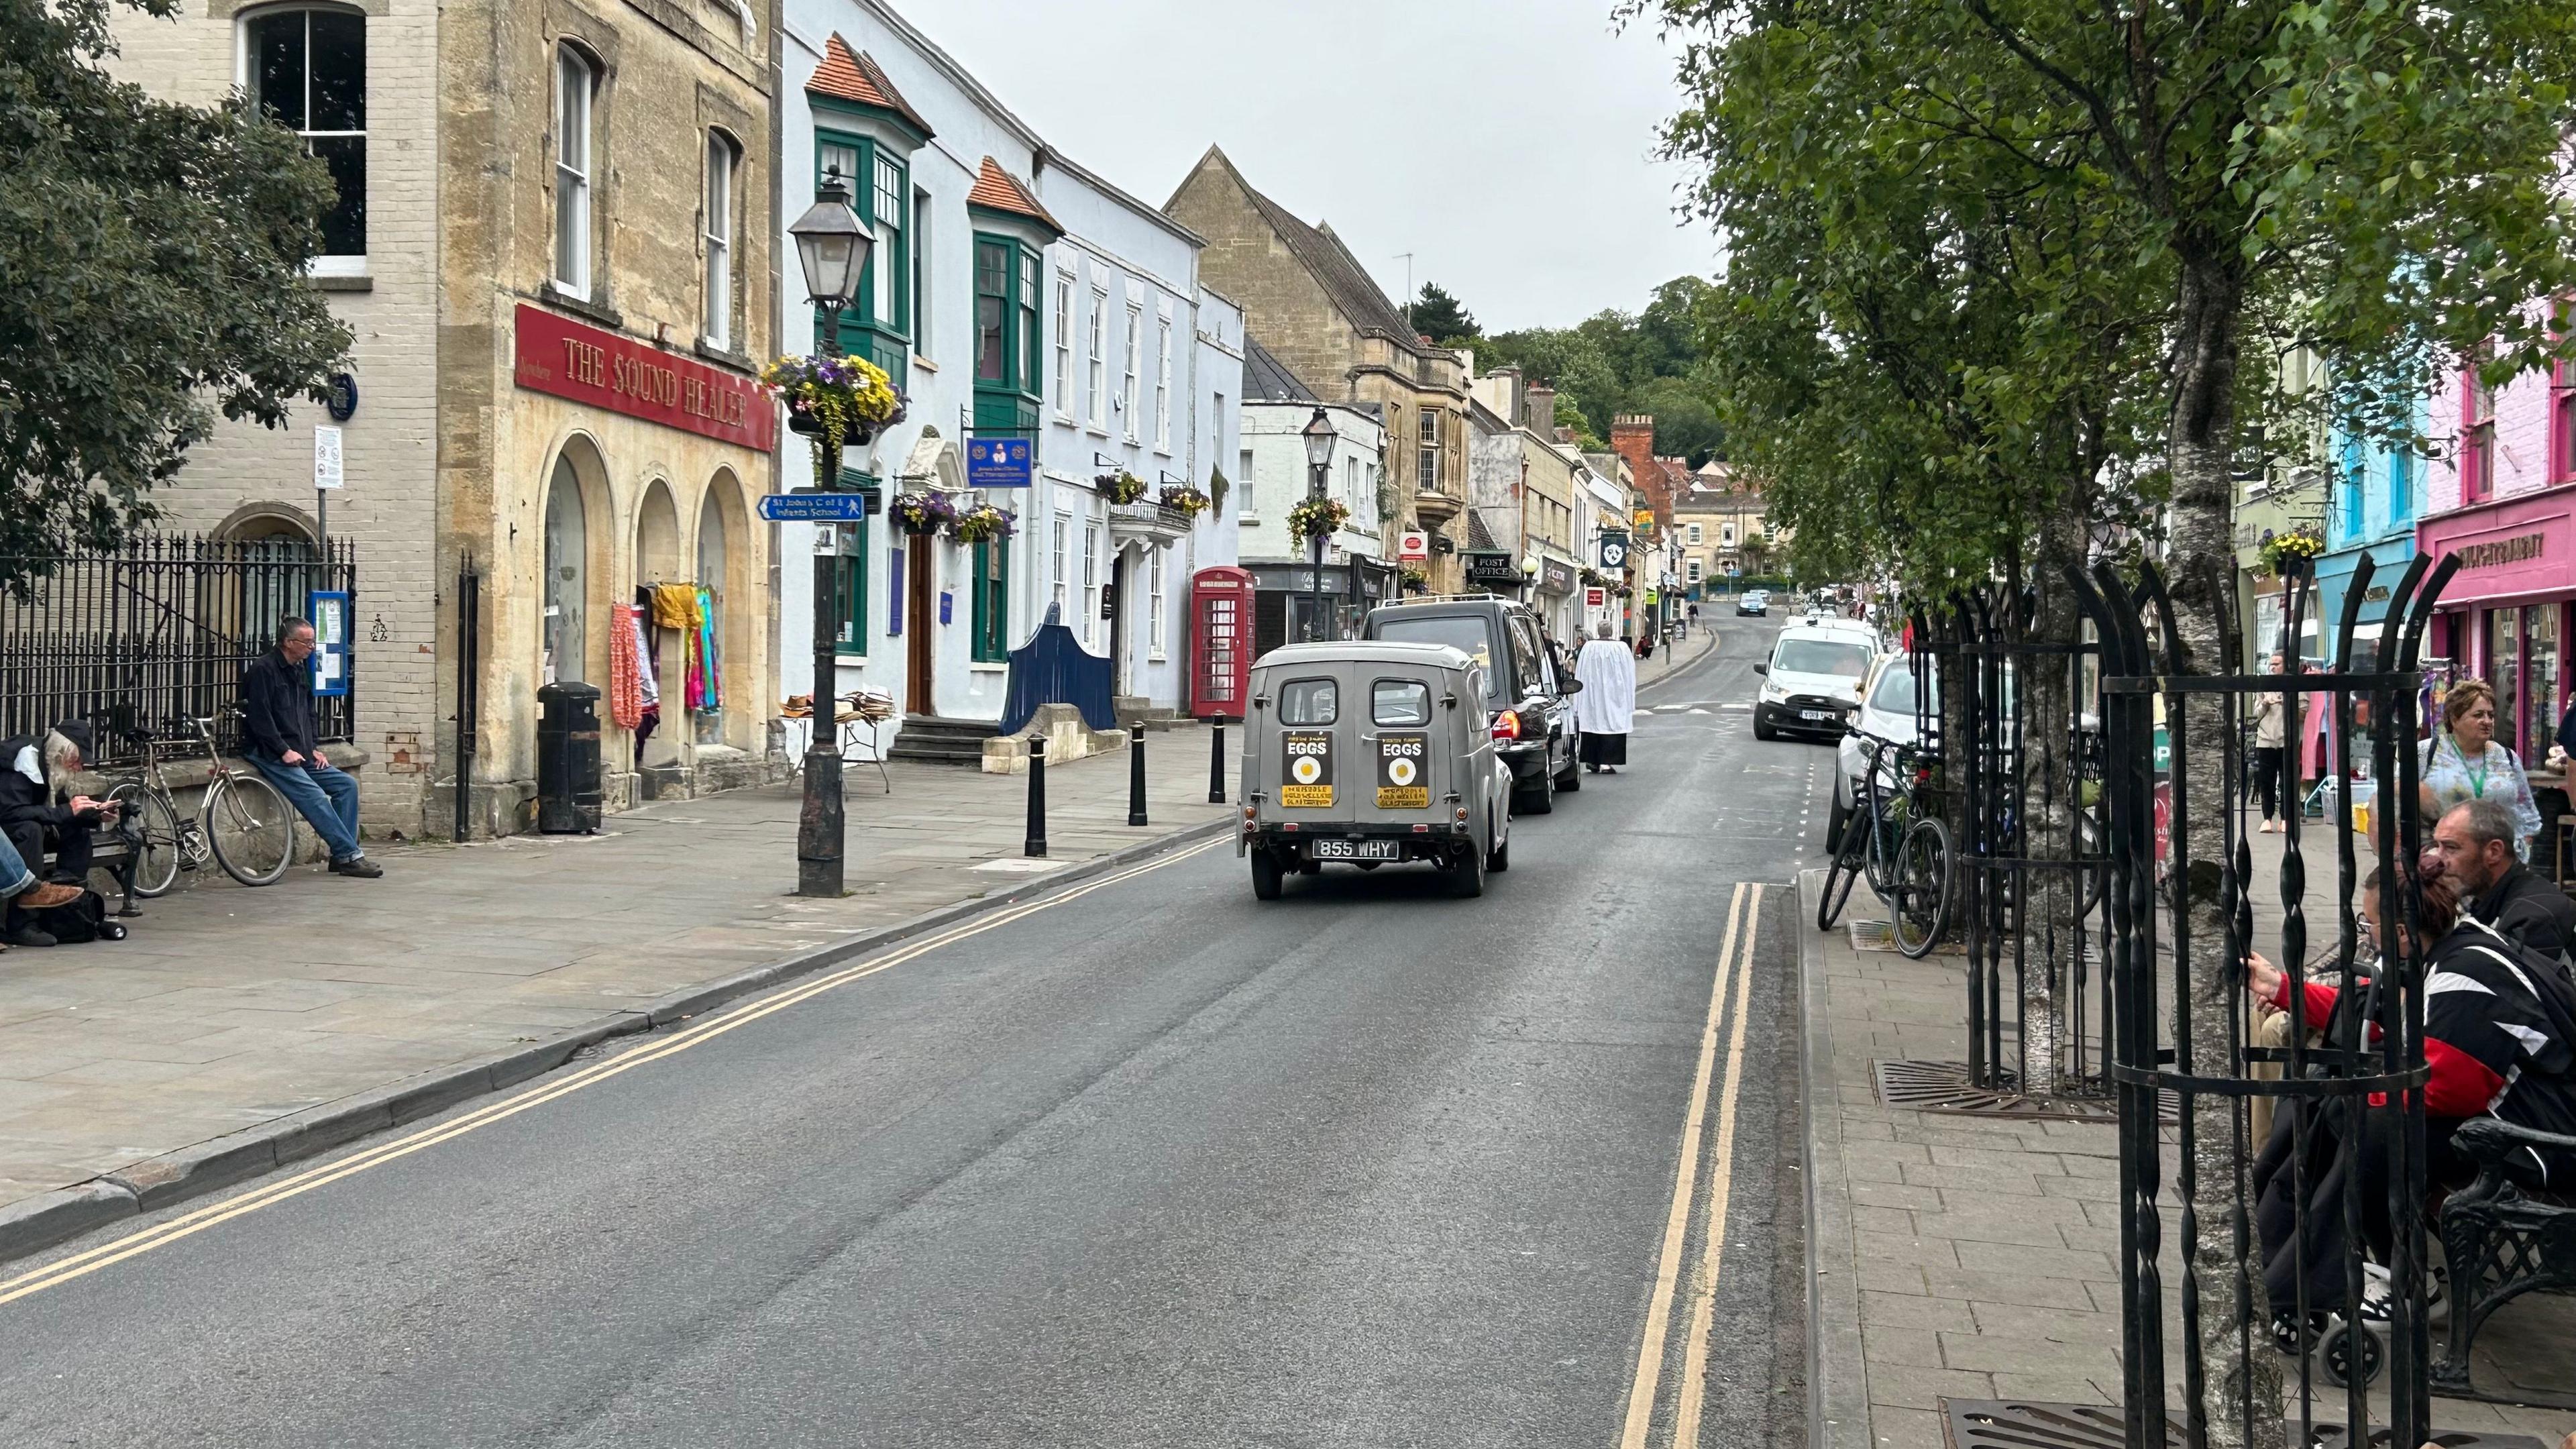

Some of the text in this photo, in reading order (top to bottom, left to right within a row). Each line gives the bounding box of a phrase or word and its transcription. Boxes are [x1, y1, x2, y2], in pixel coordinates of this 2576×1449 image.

[562, 337, 604, 388] THE
[612, 353, 678, 407] SOUND
[682, 376, 748, 429] HEALER
[816, 498, 823, 506] C
[810, 508, 841, 517] School
[1480, 558, 1504, 567] POST
[1475, 567, 1509, 576] OFFICE
[1288, 742, 1326, 755] EGGS
[1383, 743, 1421, 756] EGGS
[1320, 842, 1390, 857] 855 WHY
